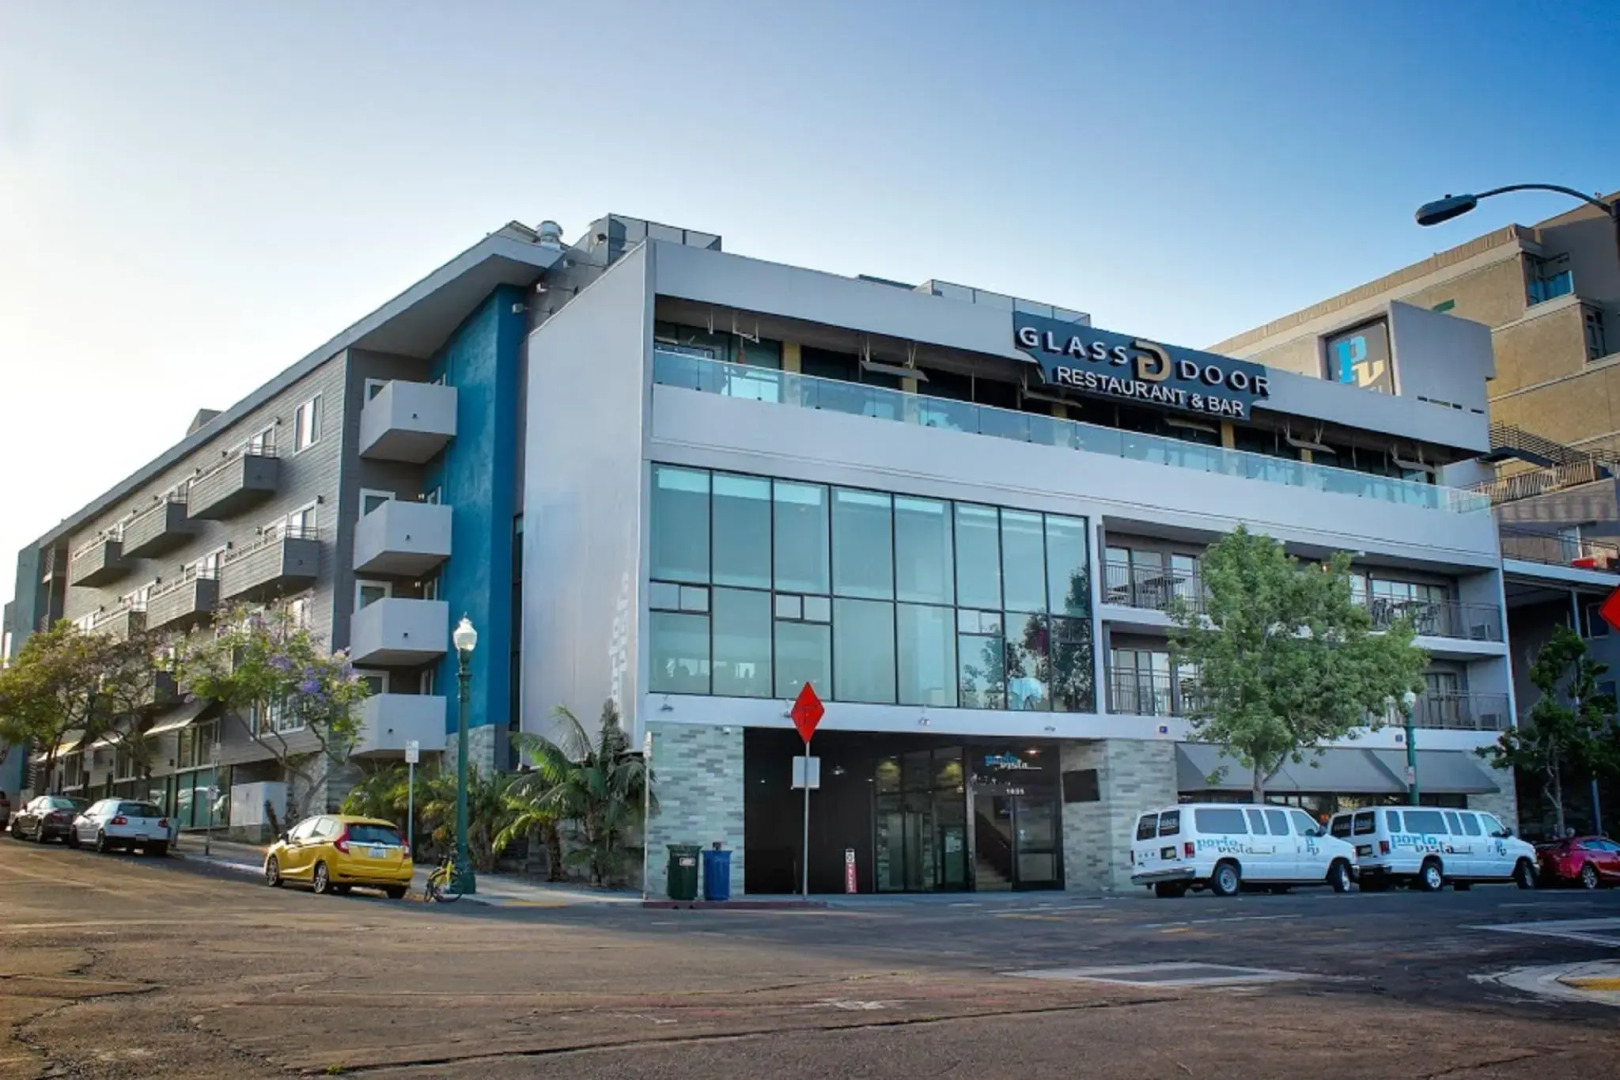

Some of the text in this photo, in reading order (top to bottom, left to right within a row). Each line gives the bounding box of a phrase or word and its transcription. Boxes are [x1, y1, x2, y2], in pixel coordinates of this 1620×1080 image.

[1019, 326, 1129, 365] GLASS
[1179, 359, 1271, 395] DOOR
[1057, 366, 1244, 415] RESTAURANT & BAR
[1196, 836, 1238, 851] porto
[1218, 843, 1253, 854] vista
[1390, 833, 1437, 849] porto
